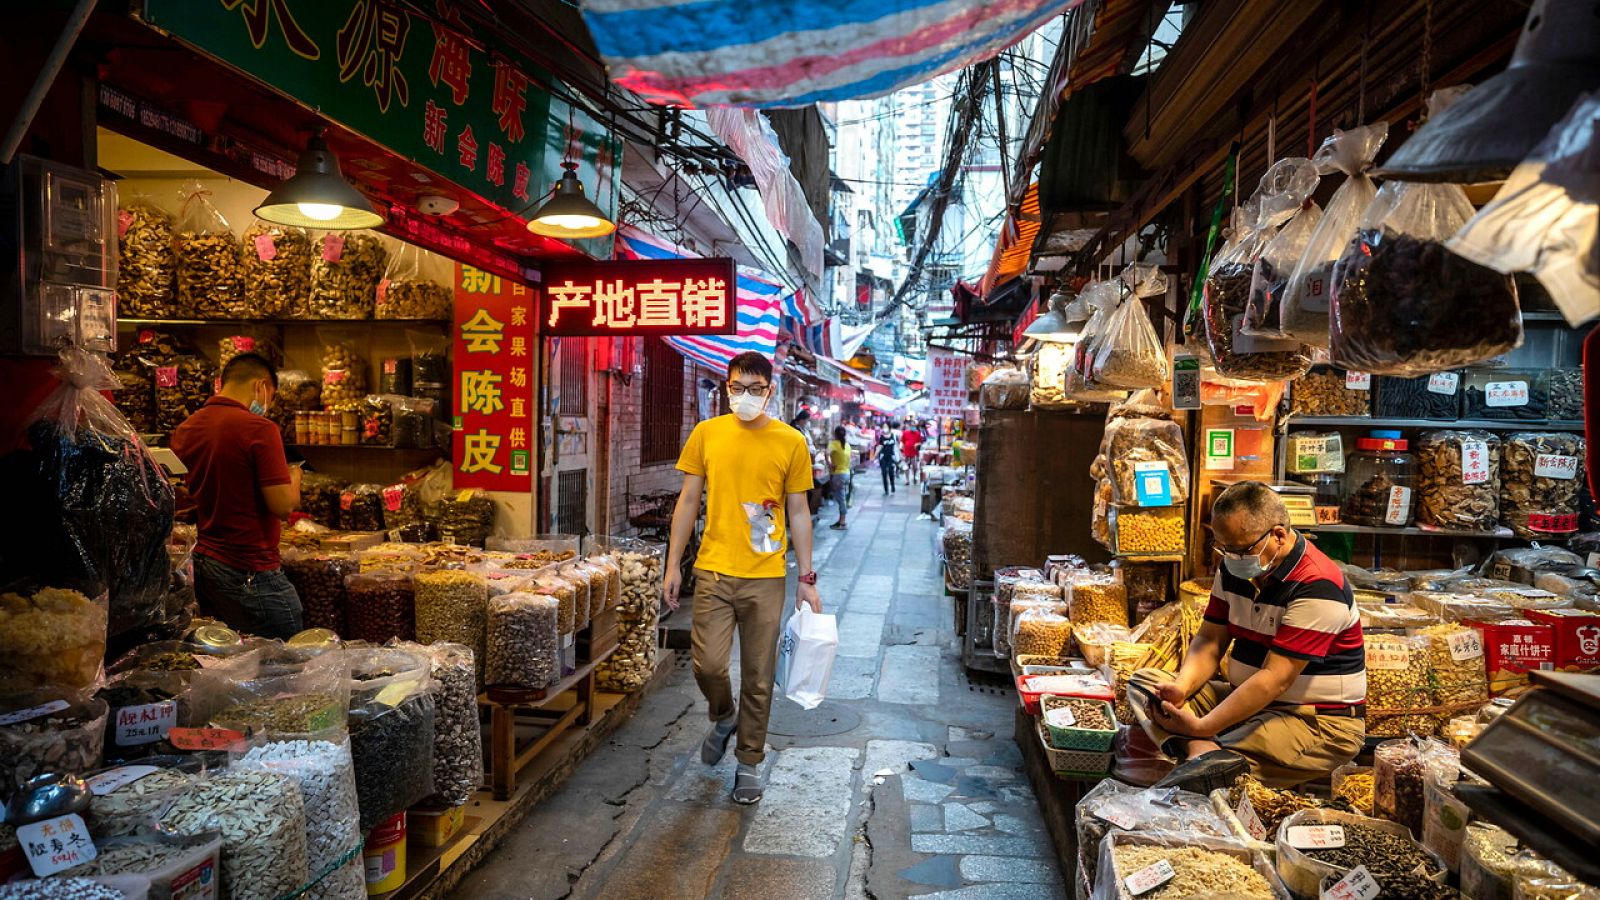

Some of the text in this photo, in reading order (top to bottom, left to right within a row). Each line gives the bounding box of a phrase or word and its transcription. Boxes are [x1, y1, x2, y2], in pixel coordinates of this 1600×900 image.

[423, 98, 531, 203] 新会陈皮
[548, 278, 725, 328] 产地直销
[460, 263, 505, 475] 新会陈皮
[1500, 643, 1551, 656] 家庭什饼干
[1513, 634, 1533, 643] 嘉顿
